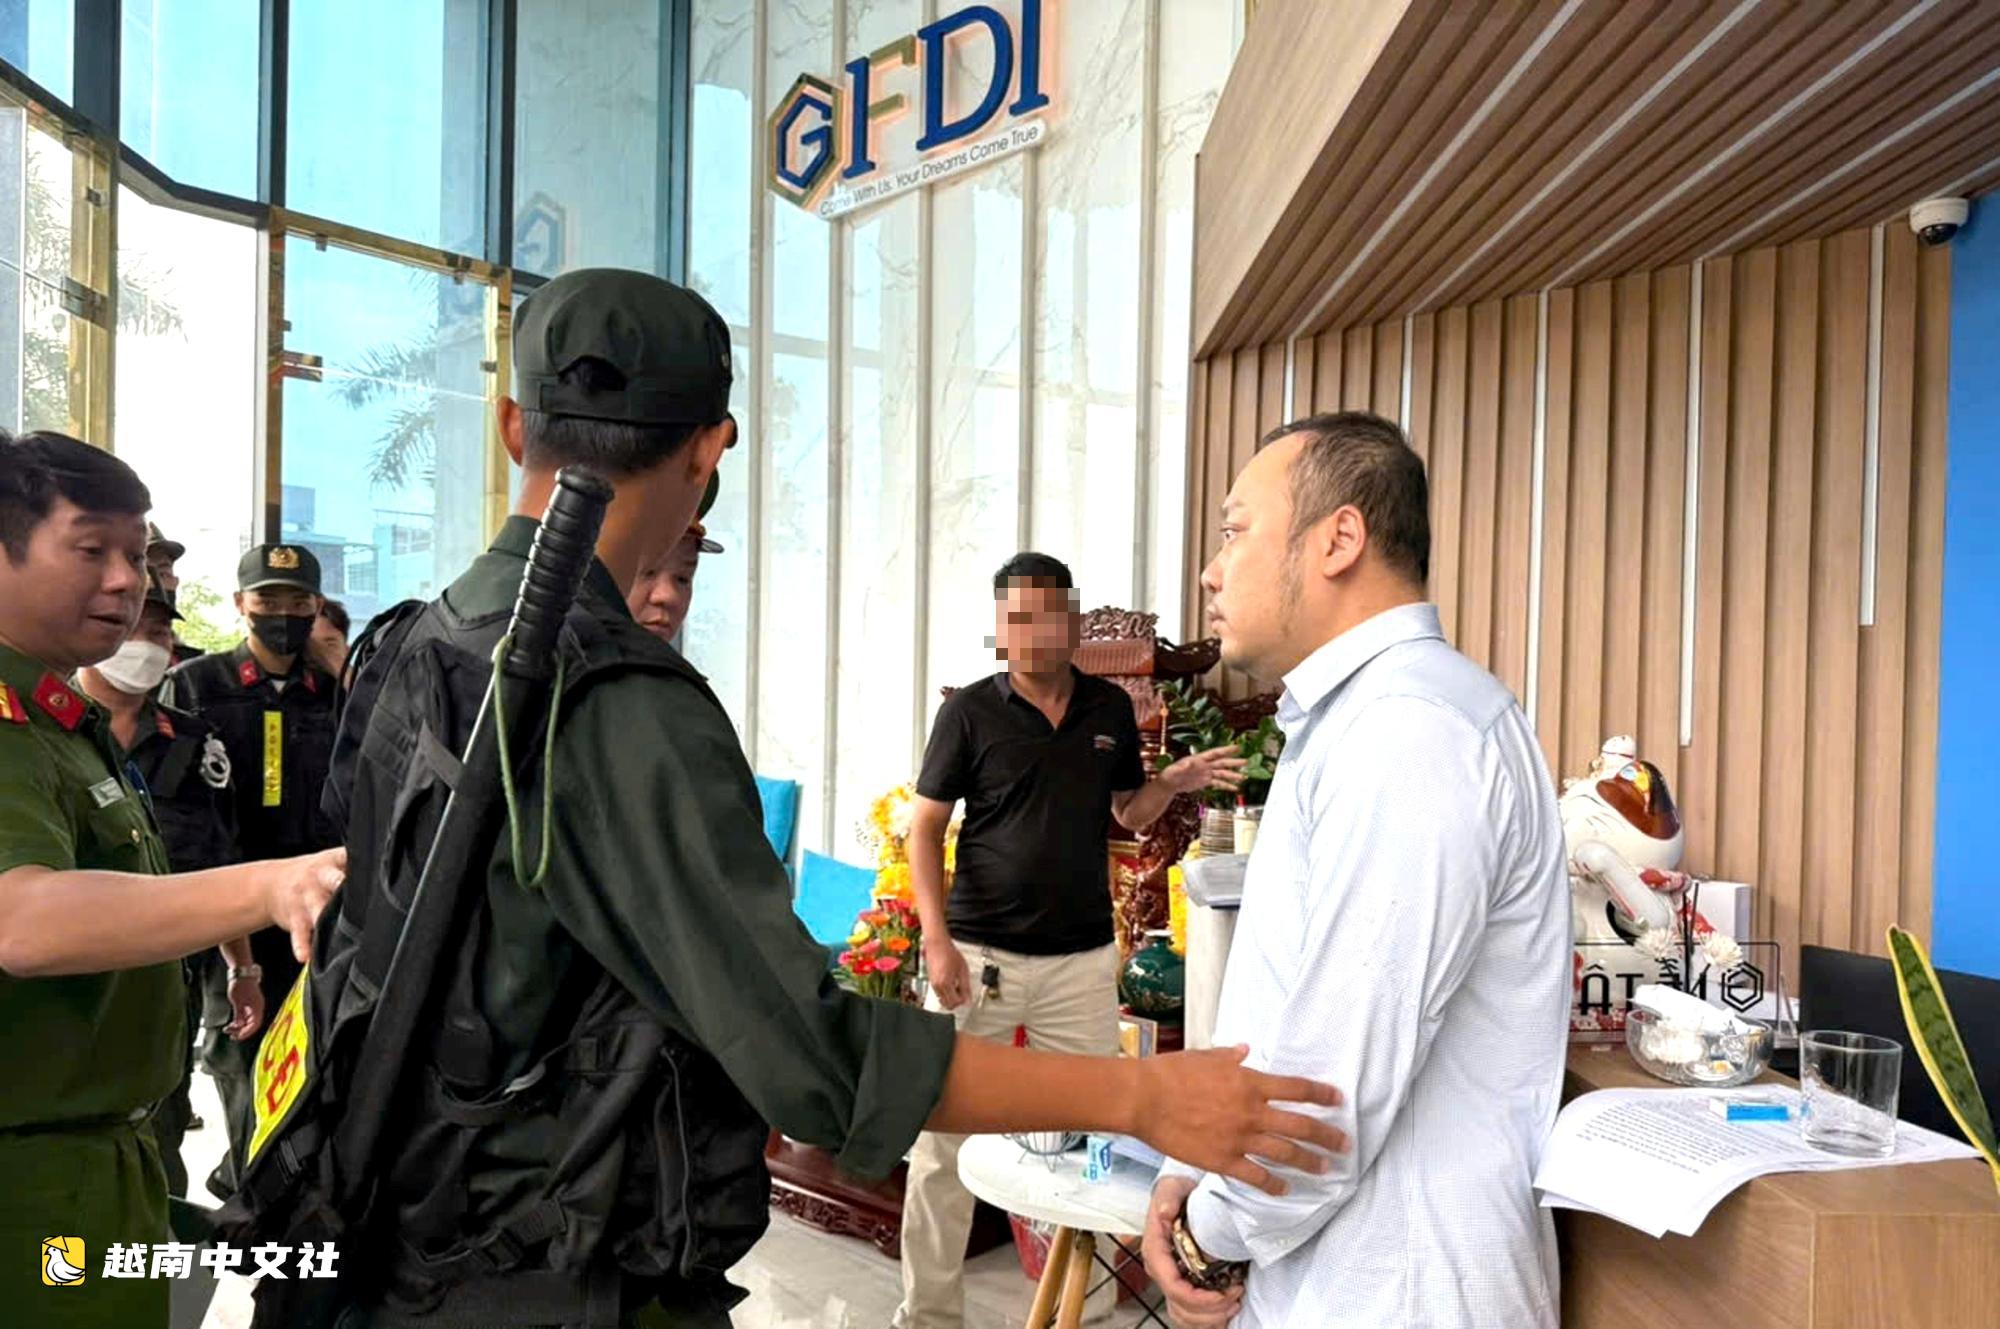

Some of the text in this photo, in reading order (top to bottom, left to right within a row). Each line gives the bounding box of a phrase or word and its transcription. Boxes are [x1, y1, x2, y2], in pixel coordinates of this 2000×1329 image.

[896, 168, 920, 188] Your
[921, 151, 968, 180] Dreams
[970, 137, 1008, 162] Come
[1011, 125, 1039, 147] True
